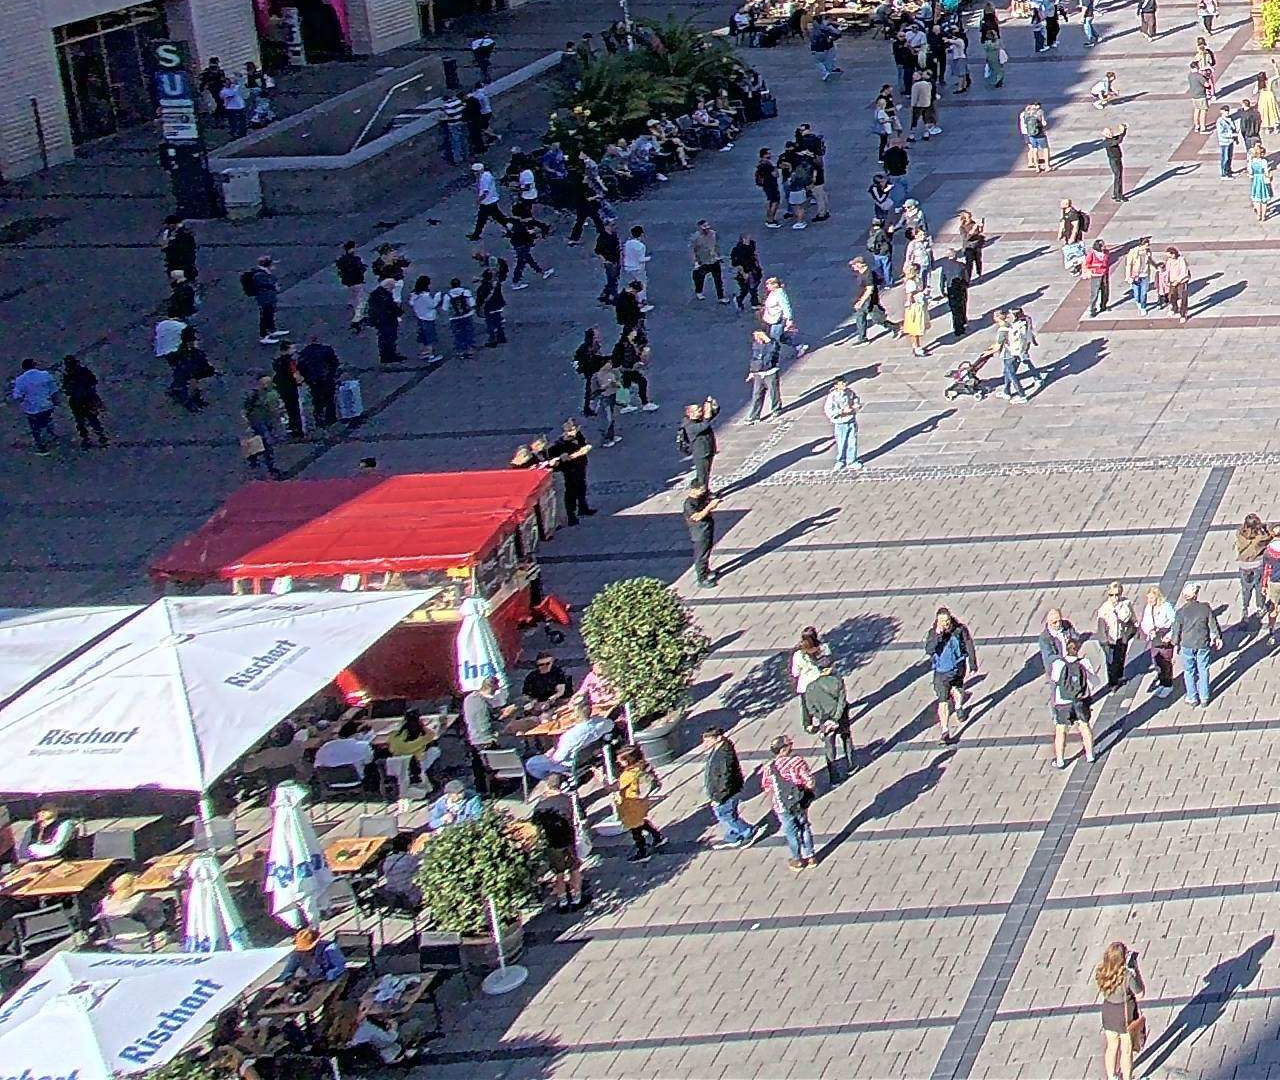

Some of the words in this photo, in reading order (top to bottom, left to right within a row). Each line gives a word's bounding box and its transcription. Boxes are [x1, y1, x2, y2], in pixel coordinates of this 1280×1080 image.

[157, 44, 181, 68] S
[161, 74, 184, 96] U
[223, 639, 297, 688] Rischart
[36, 726, 141, 747] Rischart
[118, 979, 224, 1064] Rischart
